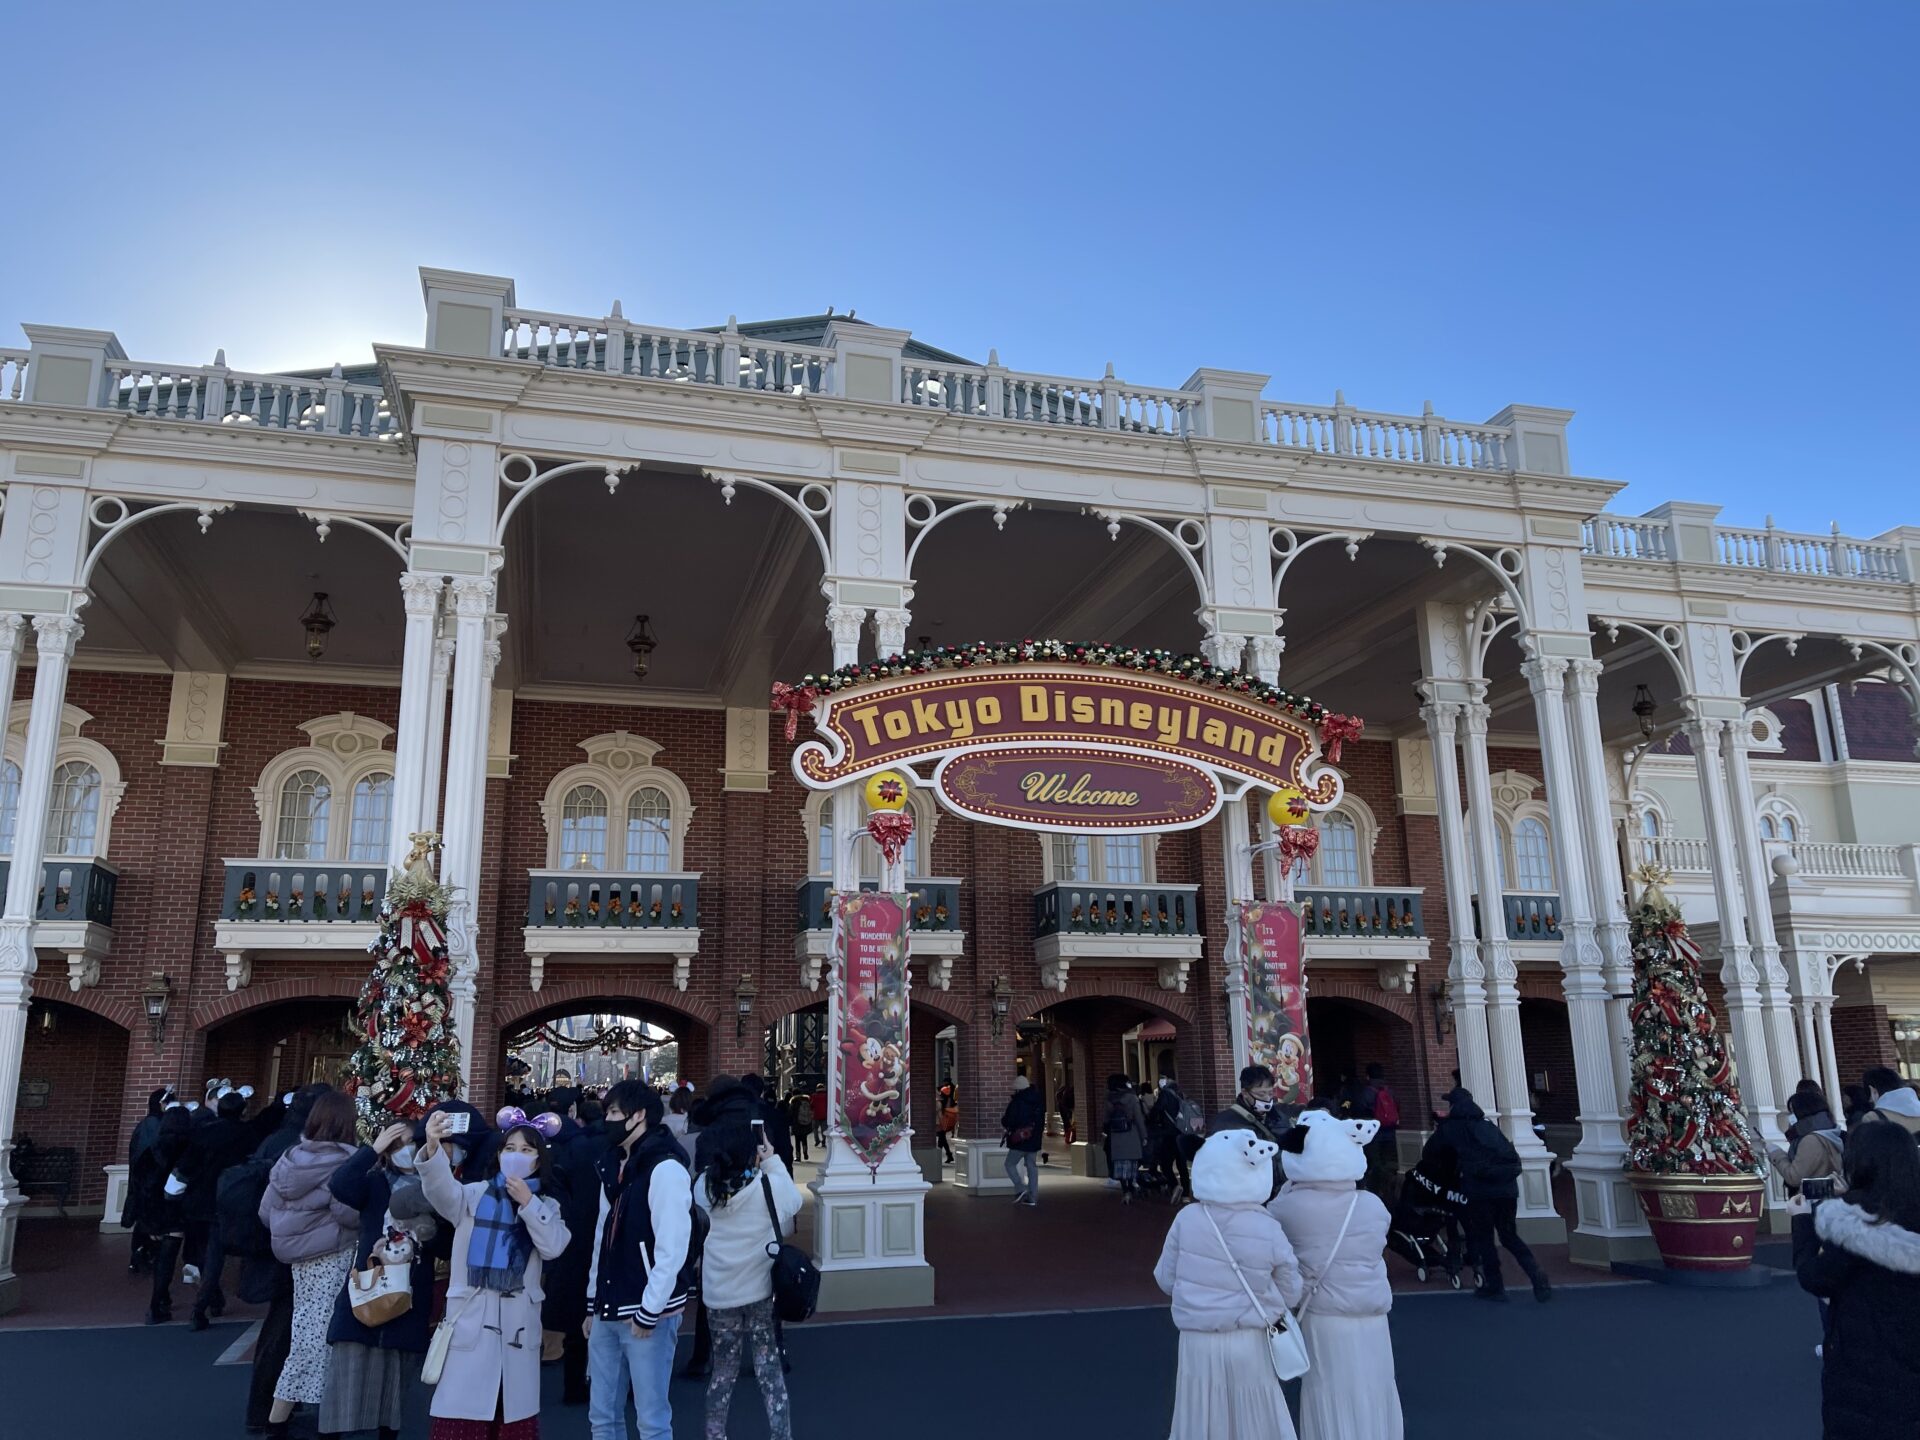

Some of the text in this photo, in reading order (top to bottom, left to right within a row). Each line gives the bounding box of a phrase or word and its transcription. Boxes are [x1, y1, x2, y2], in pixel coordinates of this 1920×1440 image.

[852, 685, 1287, 767] Tokyo Disneyland
[1020, 770, 1140, 807] Welcome
[860, 945, 868, 953] TO
